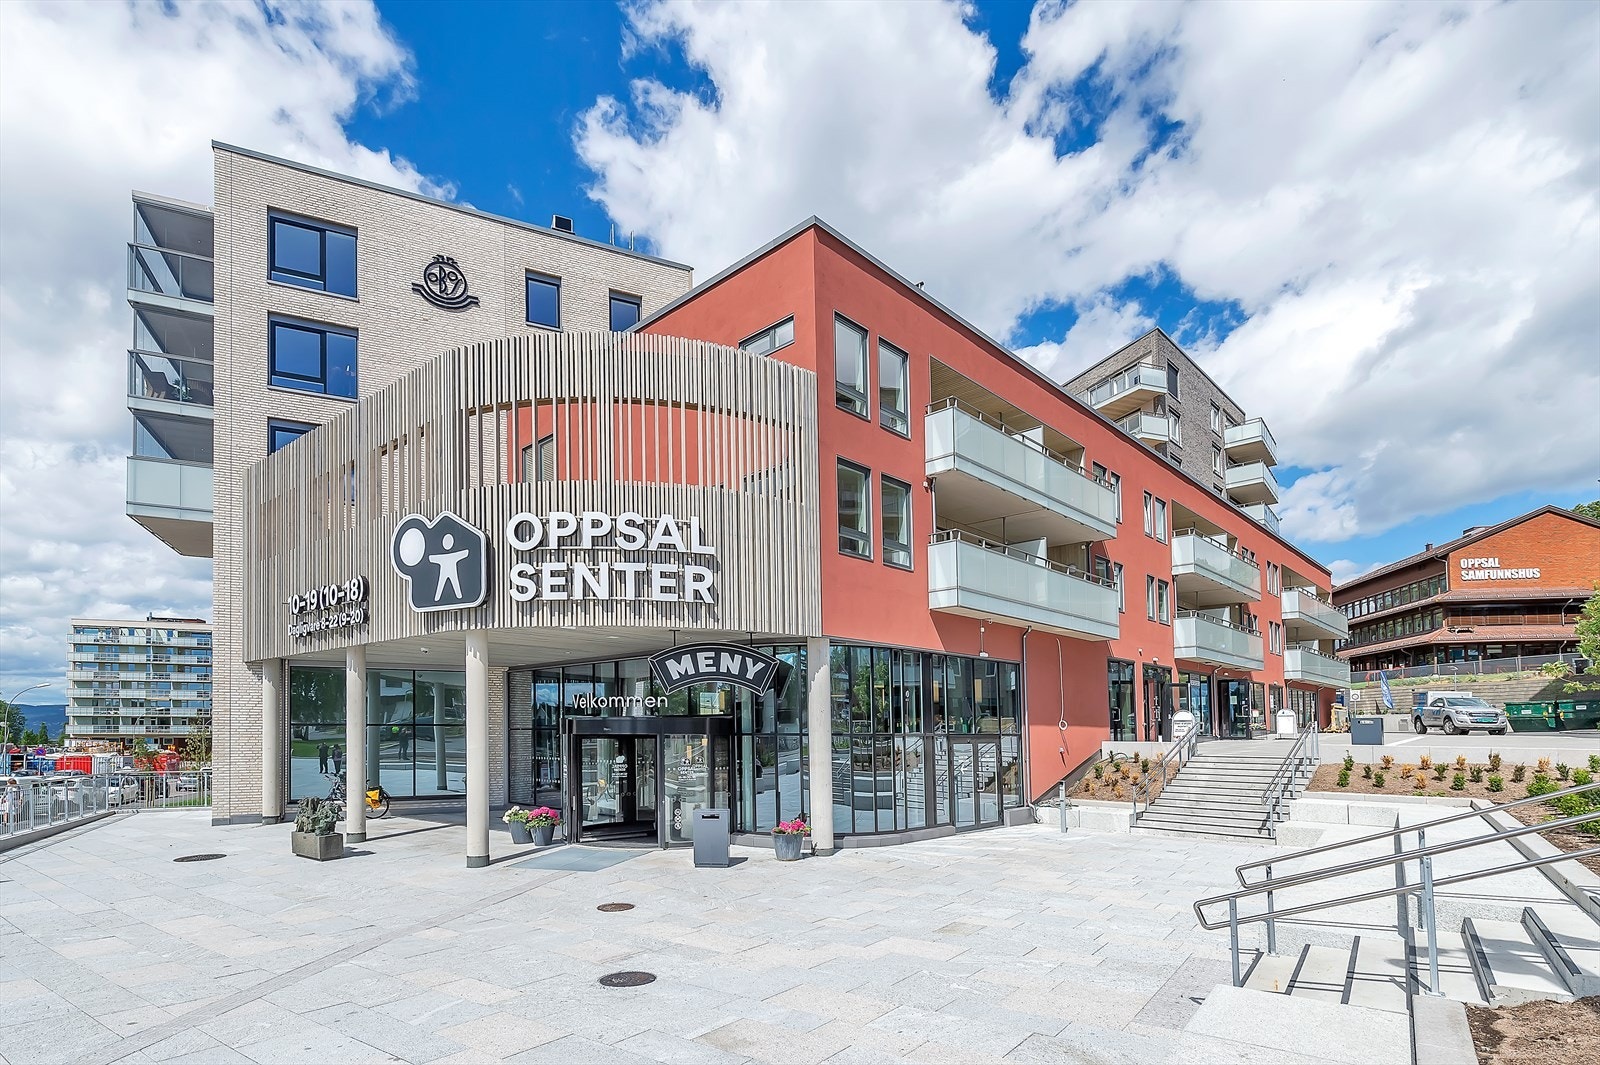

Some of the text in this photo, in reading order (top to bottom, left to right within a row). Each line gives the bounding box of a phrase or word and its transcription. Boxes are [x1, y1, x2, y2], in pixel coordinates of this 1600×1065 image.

[506, 511, 716, 555] OPPSAL
[1460, 557, 1500, 569] OPPSAL
[1461, 567, 1541, 581] SAMFUNNSHUS
[288, 574, 364, 616] 10-19 (10-18)
[509, 561, 714, 604] SENTER
[665, 651, 766, 681] MENY
[572, 692, 668, 709] Velkommen
